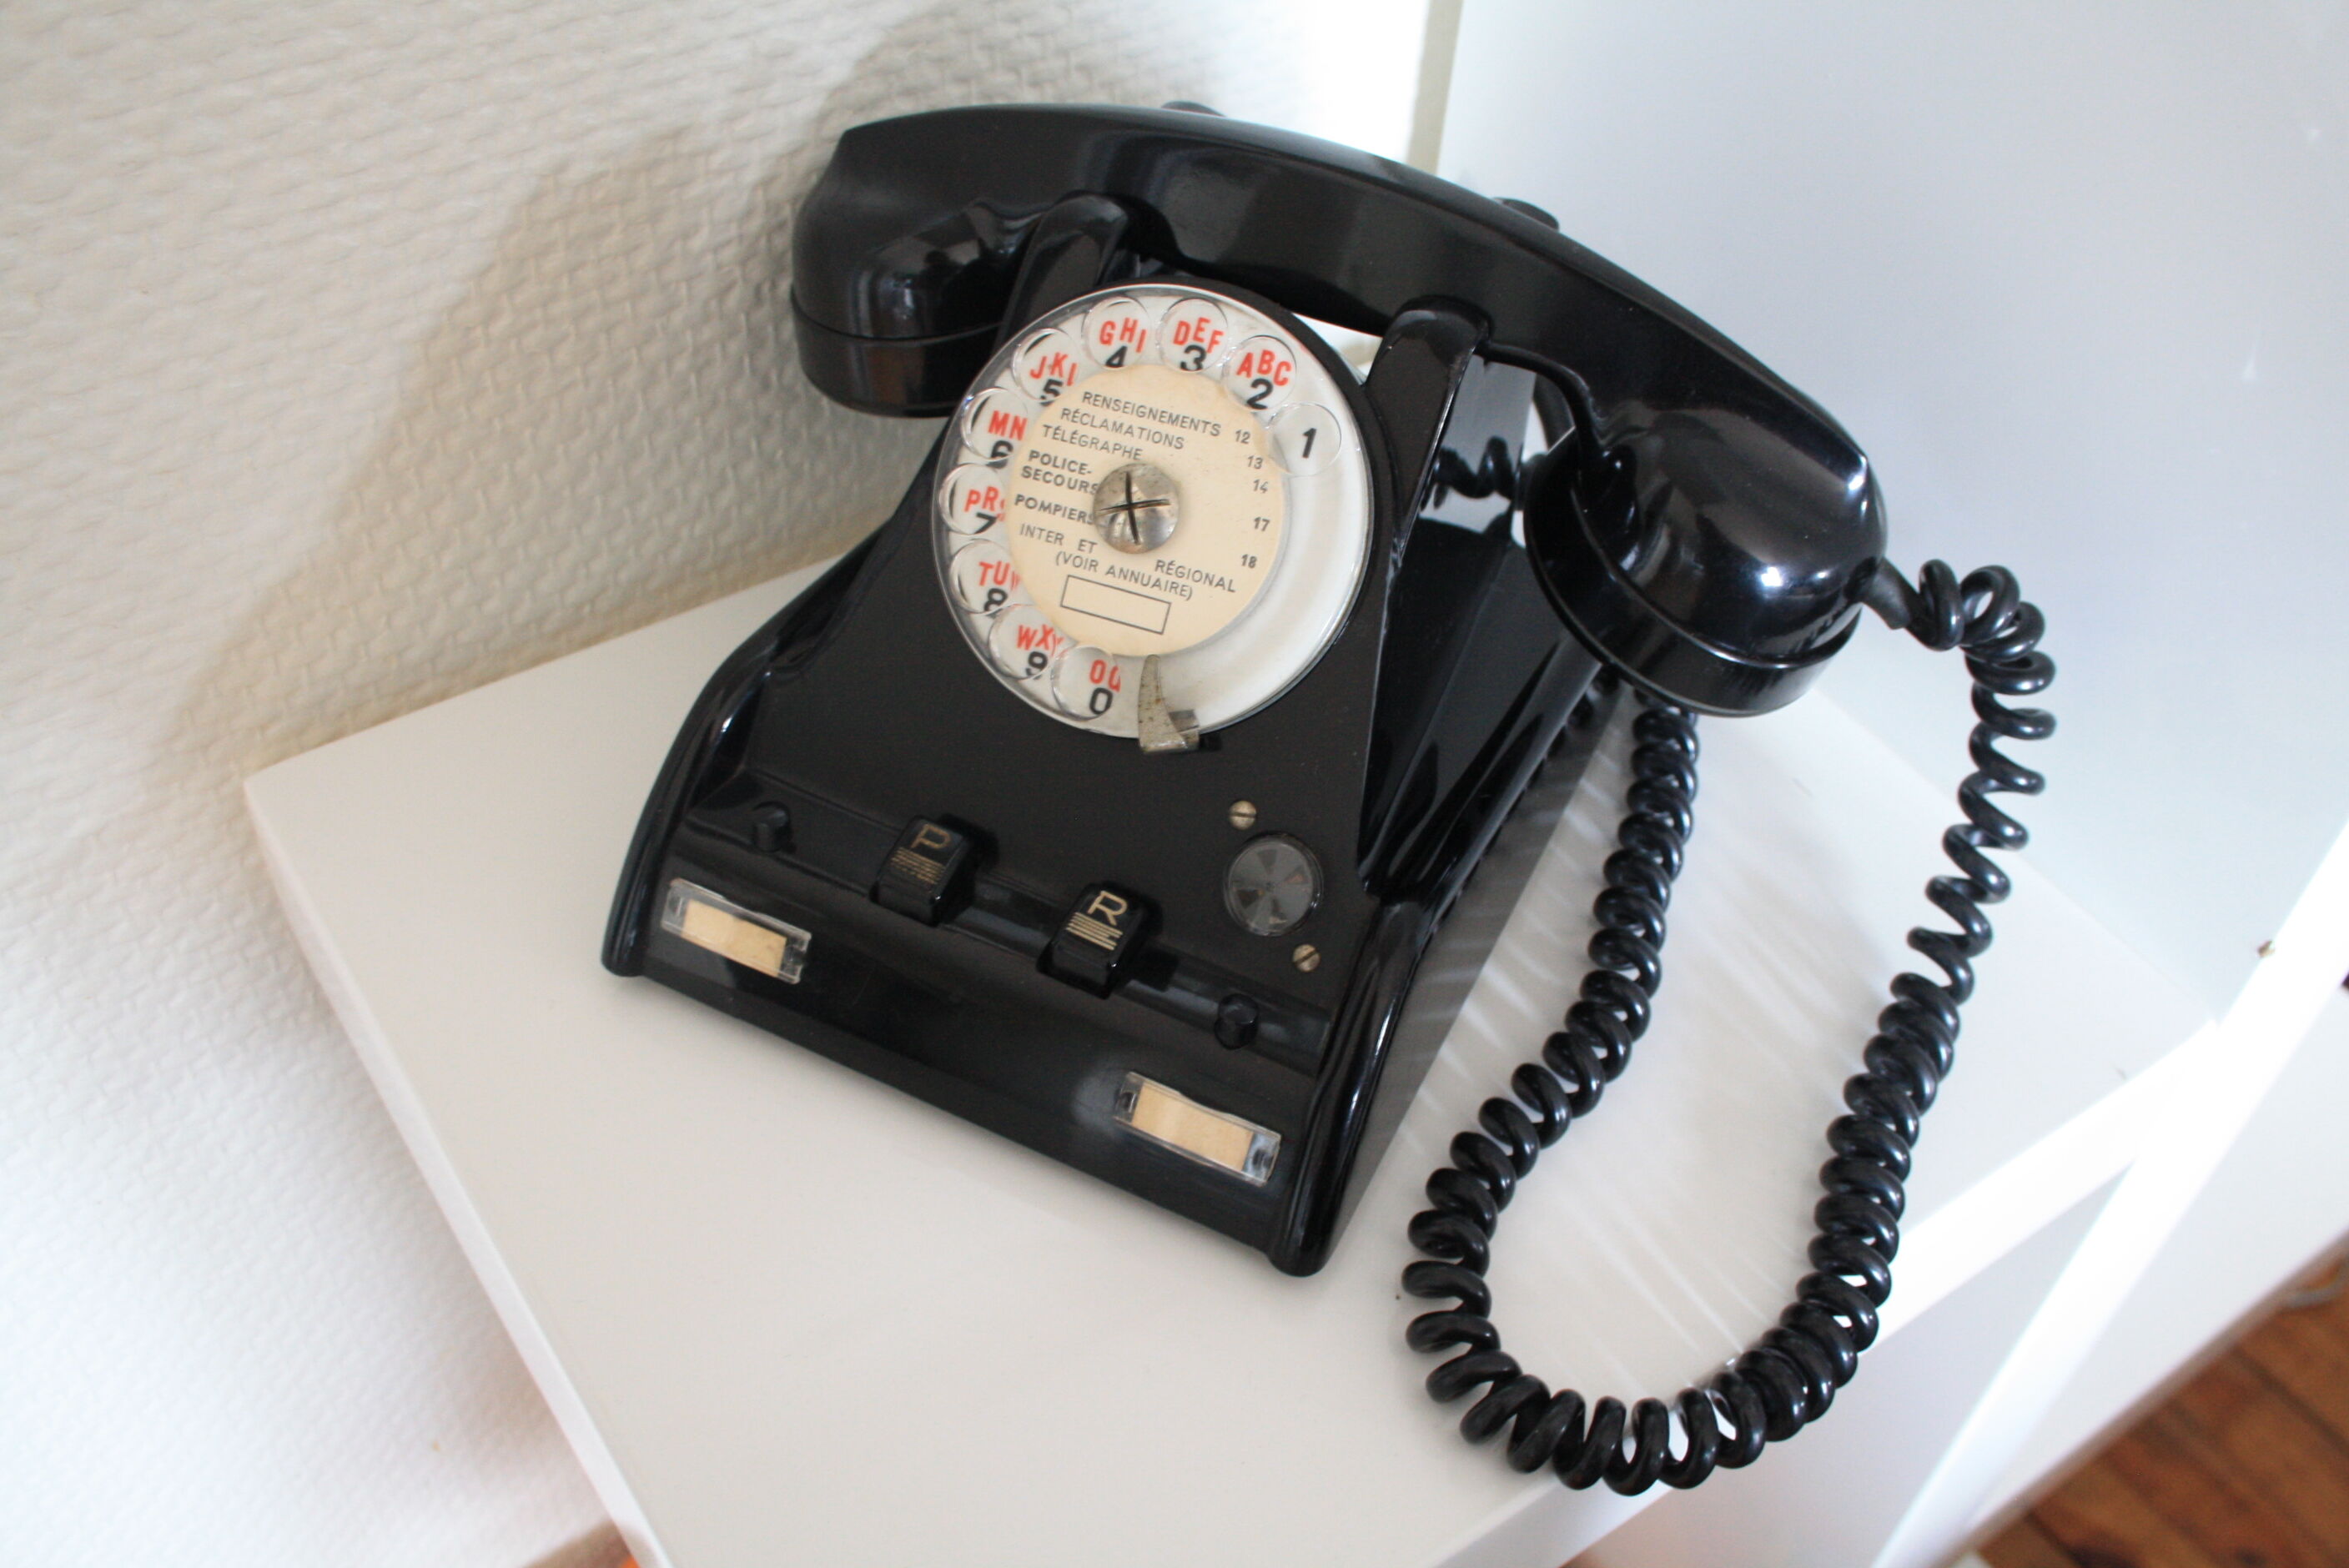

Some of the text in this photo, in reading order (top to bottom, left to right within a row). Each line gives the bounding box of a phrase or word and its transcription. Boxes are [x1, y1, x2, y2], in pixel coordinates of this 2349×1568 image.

[1099, 317, 1147, 353] GHI
[1173, 316, 1225, 354] DEF
[1105, 345, 1128, 369] 4
[1180, 344, 1207, 372] 3
[1236, 349, 1292, 386] ABC
[1039, 378, 1064, 408] 5
[1246, 378, 1273, 410] 2
[1083, 391, 1251, 445] RENSEIGNEMENTS 12
[1060, 406, 1263, 470] RÉCLAMATIONS 13
[1302, 427, 1317, 460] 1
[1029, 450, 1092, 475] POLICE-
[1043, 423, 1269, 494] TÉLÉGRAPHE 14
[1021, 465, 1270, 532] SECOURS 17
[975, 510, 998, 534] 7
[1019, 523, 1236, 593] INTER ET RÉGIONAL
[1241, 554, 1258, 569] 18
[1055, 550, 1194, 601] (VOIR ANNUAIRE)
[1025, 651, 1048, 680] 9
[911, 822, 951, 850] P
[1087, 889, 1128, 926] R
